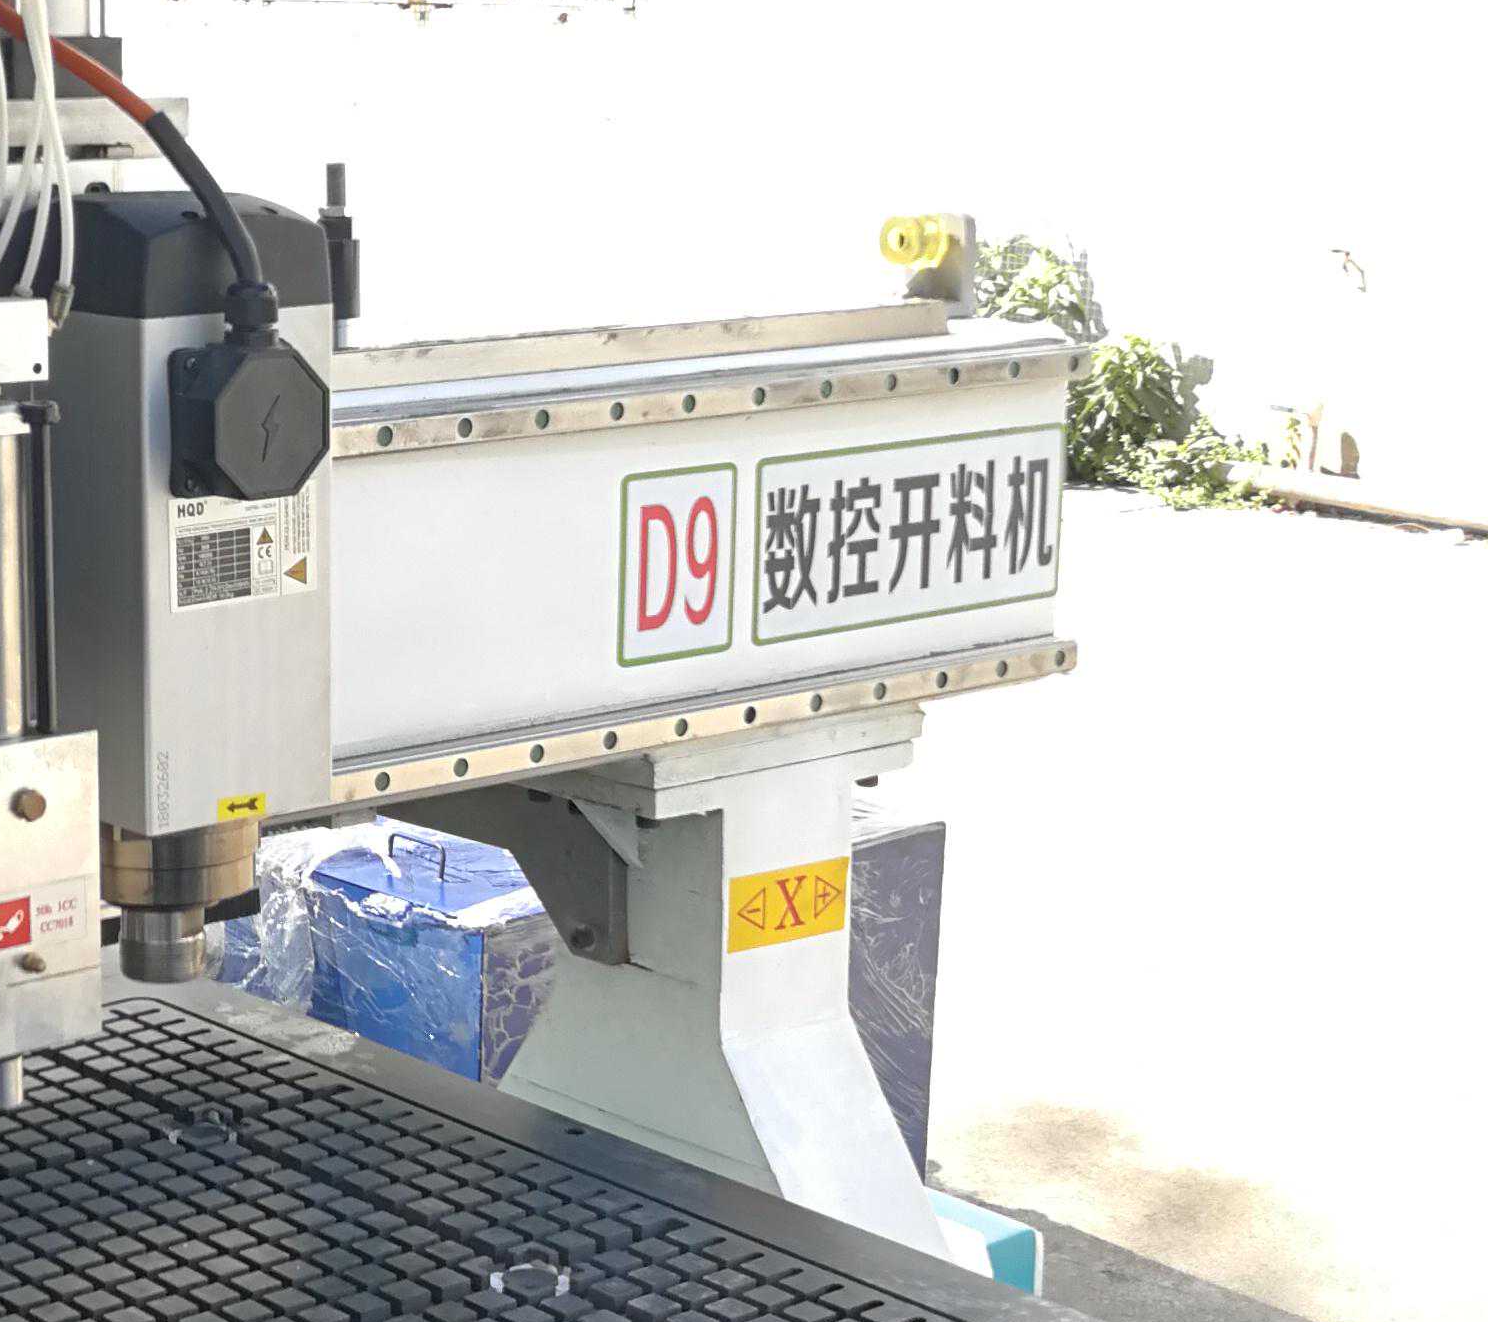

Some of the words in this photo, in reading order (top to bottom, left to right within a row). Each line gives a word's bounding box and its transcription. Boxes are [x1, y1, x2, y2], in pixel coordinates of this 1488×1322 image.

[177, 502, 205, 518] HQD
[762, 455, 1054, 614] 数控开料机
[637, 495, 719, 633] D9
[774, 875, 807, 931] X
